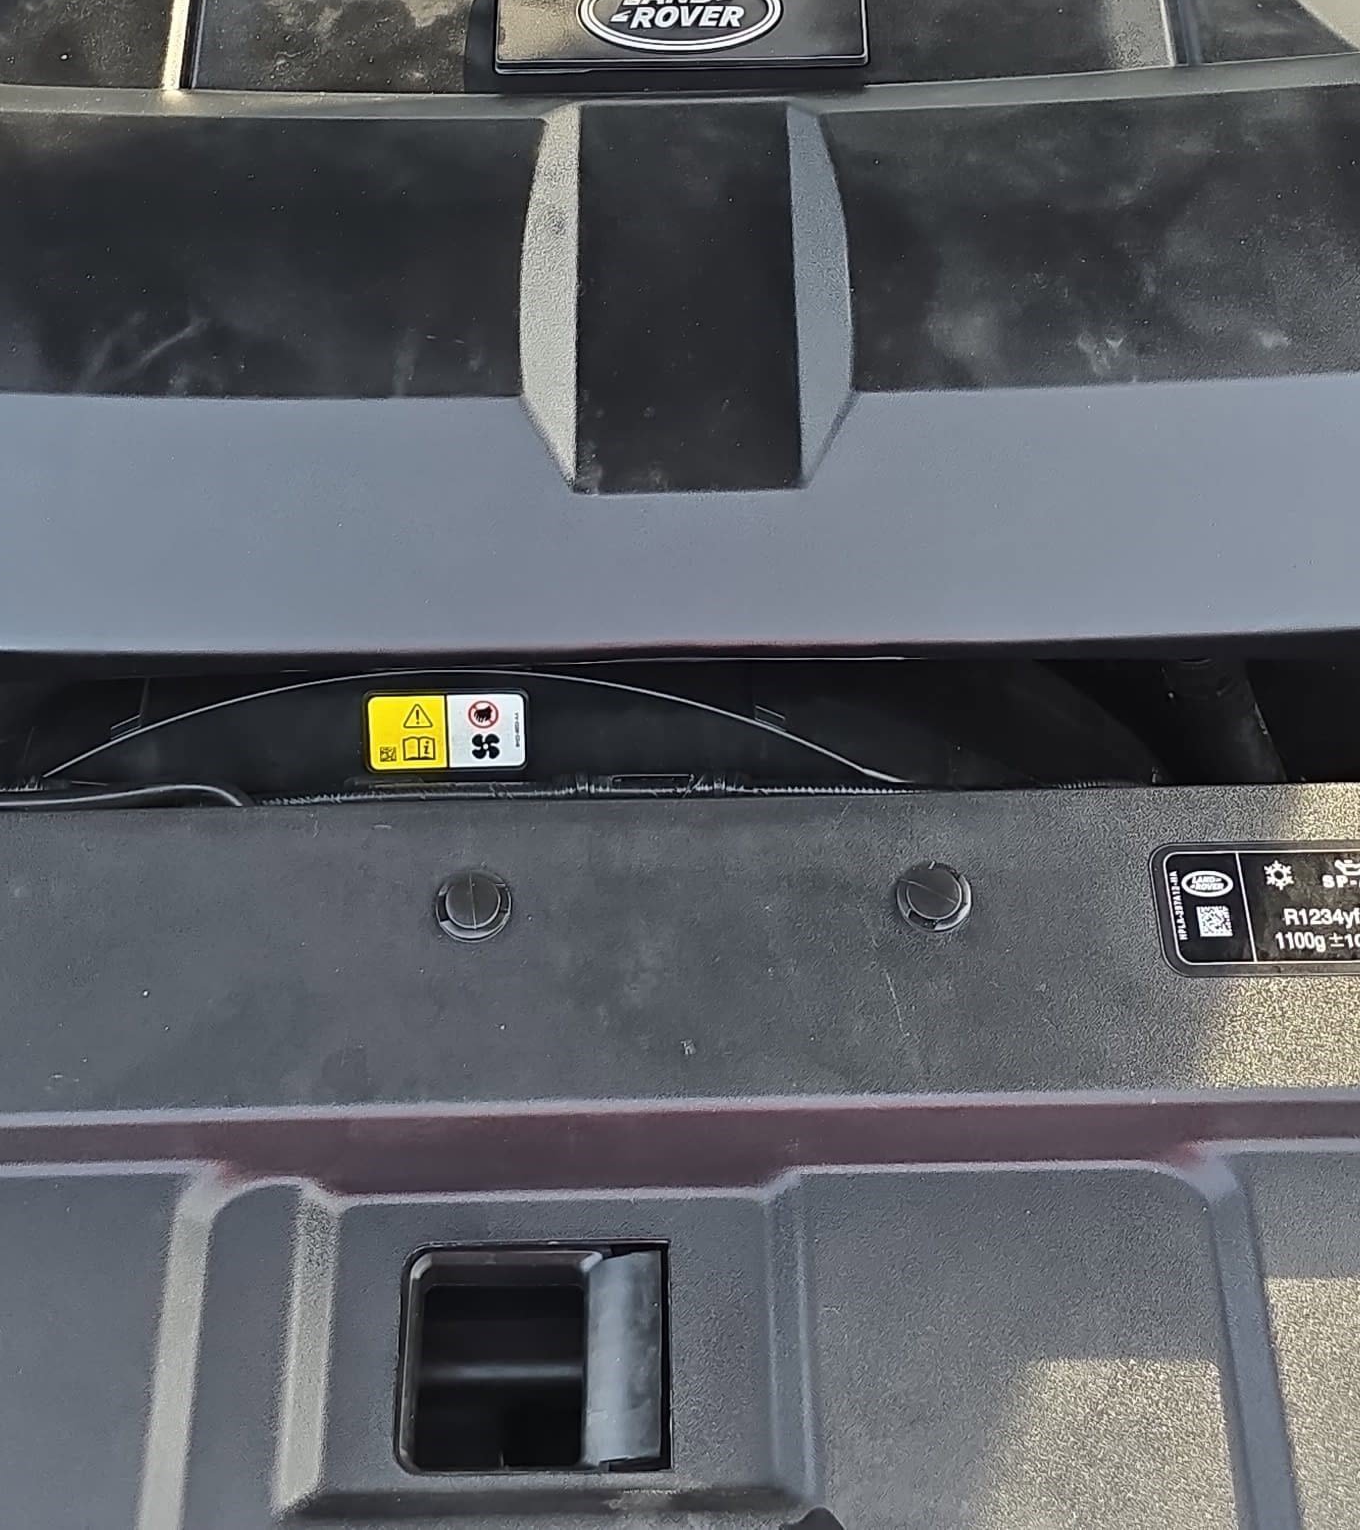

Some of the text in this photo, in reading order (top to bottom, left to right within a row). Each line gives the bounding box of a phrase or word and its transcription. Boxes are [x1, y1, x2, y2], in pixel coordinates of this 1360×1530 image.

[629, 5, 745, 29] ROVER
[1283, 908, 1360, 929] R1234yf
[1275, 932, 1327, 952] 1100g
